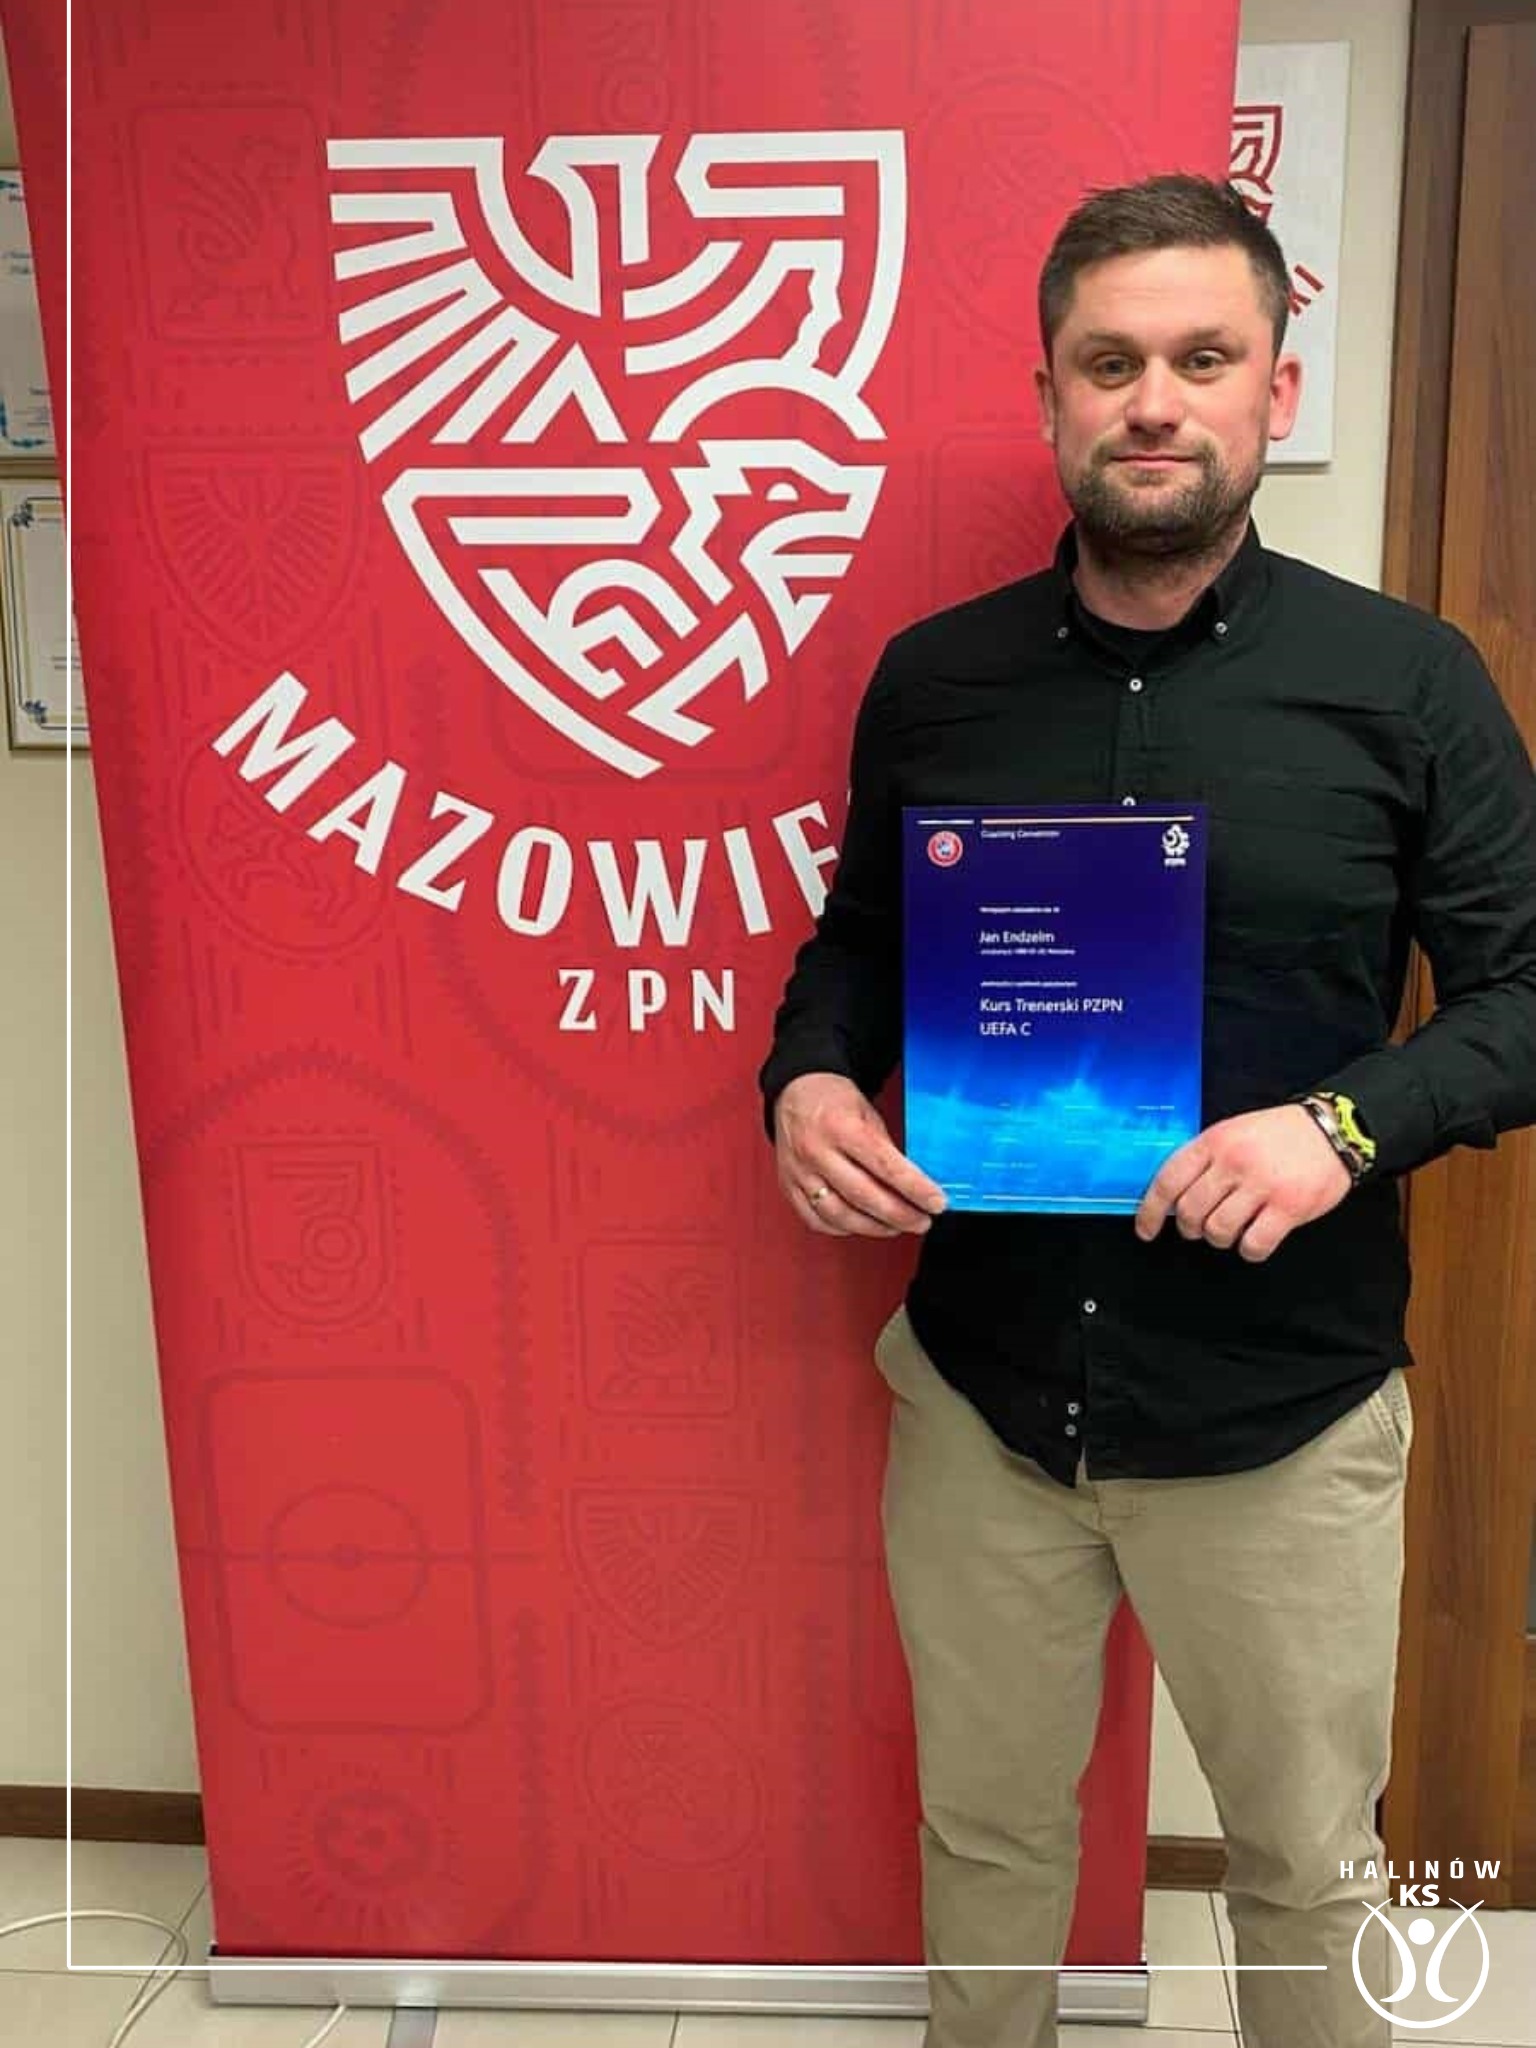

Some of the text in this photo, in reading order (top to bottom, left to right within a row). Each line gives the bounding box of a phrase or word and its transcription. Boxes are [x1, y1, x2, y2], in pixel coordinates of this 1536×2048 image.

[211, 670, 850, 948] MAZOWIE
[979, 931, 1000, 943] Jan
[558, 968, 735, 1031] ZPN
[980, 997, 1123, 1013] Kurs Trenerski PZPN
[980, 1021, 1032, 1036] UEFA C
